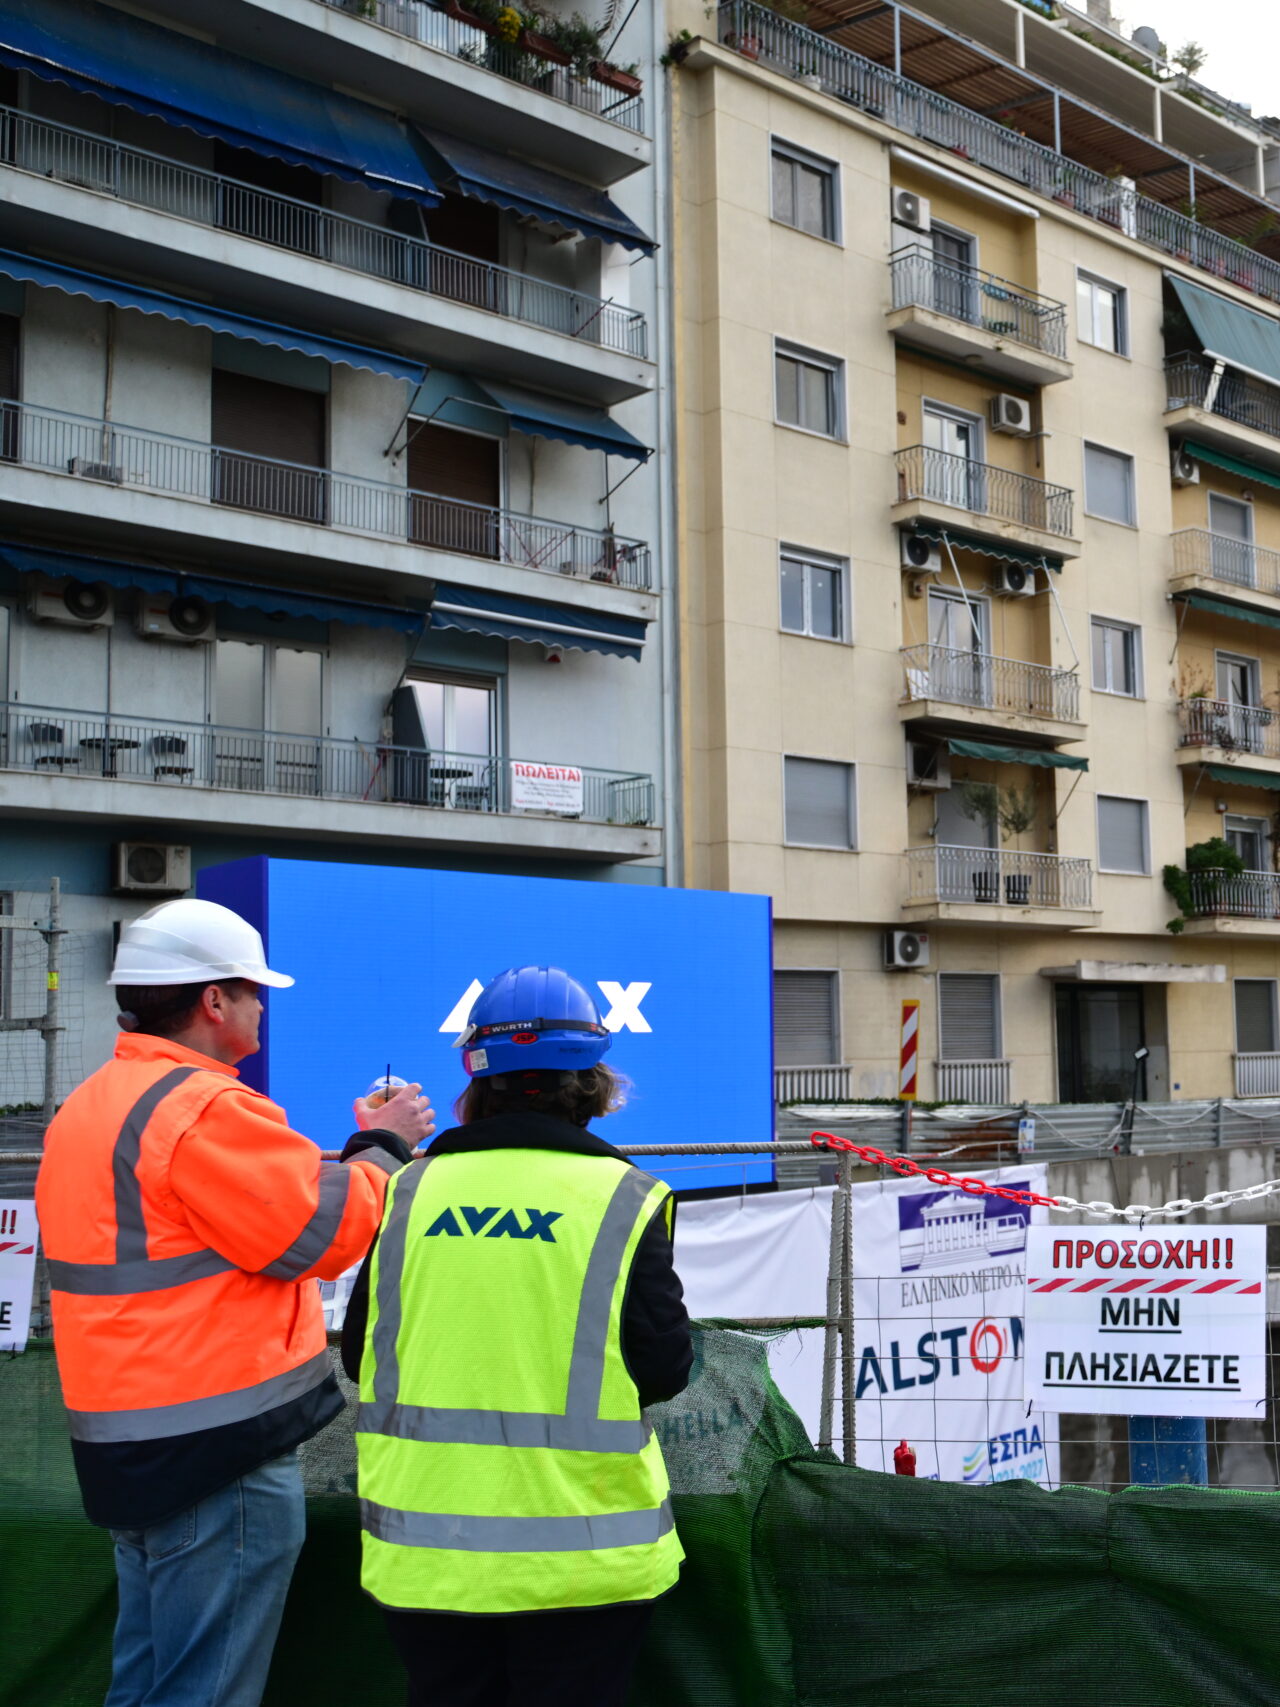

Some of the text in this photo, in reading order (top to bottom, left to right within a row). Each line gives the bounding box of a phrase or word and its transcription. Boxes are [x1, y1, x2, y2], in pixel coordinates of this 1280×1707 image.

[515, 763, 581, 782] ΠΩΛΕΙΤΑΙ
[438, 978, 653, 1033] AX
[424, 1206, 564, 1243] AVAX
[1052, 1237, 1234, 1269] ΠΡΟΣΟΧΗ!!
[901, 1272, 970, 1308] ΕΛΛΗΝΙΚΟ
[972, 1263, 1013, 1295] ΜΕΤΡΟ
[1100, 1297, 1181, 1327] ΜΗΝ
[1044, 1352, 1240, 1384] ΠΛΗΣΙΑΖΕΤΕ
[988, 1424, 1043, 1466] ΕΣΠΑ
